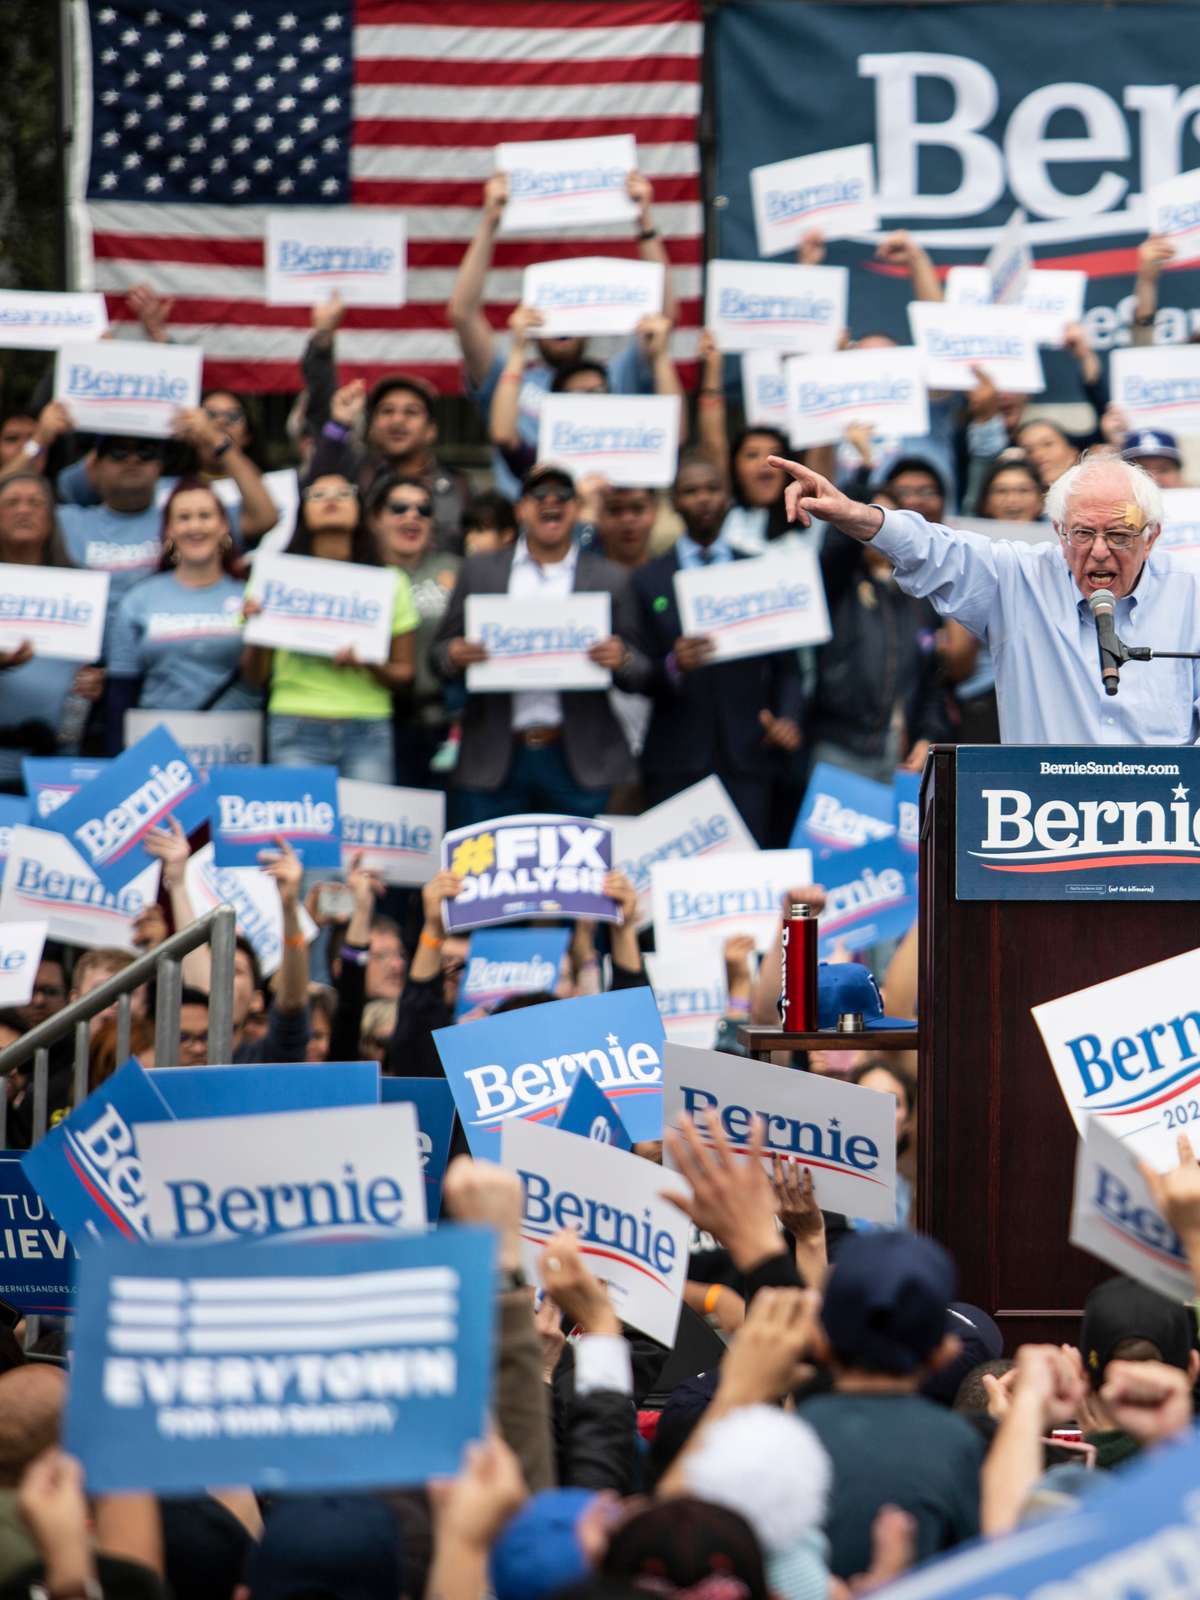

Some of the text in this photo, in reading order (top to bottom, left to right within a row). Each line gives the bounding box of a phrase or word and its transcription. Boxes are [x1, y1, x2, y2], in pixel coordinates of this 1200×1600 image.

[277, 238, 394, 273] Bernie
[0, 307, 93, 327] ernie
[67, 363, 190, 400] Bernie
[551, 419, 666, 453] Bernie
[0, 591, 93, 624] ernie
[262, 577, 381, 625] Bernie
[1040, 761, 1180, 776] BernieSanders.com
[75, 759, 193, 863] Bernie
[217, 793, 336, 833] Bernie
[341, 815, 432, 850] ernie
[452, 825, 608, 876] #FIX
[464, 1032, 663, 1117] Bernie
[166, 1163, 402, 1238] Bernie
[516, 1169, 676, 1274] Bernie
[103, 1347, 457, 1408] EVERYTOWN
